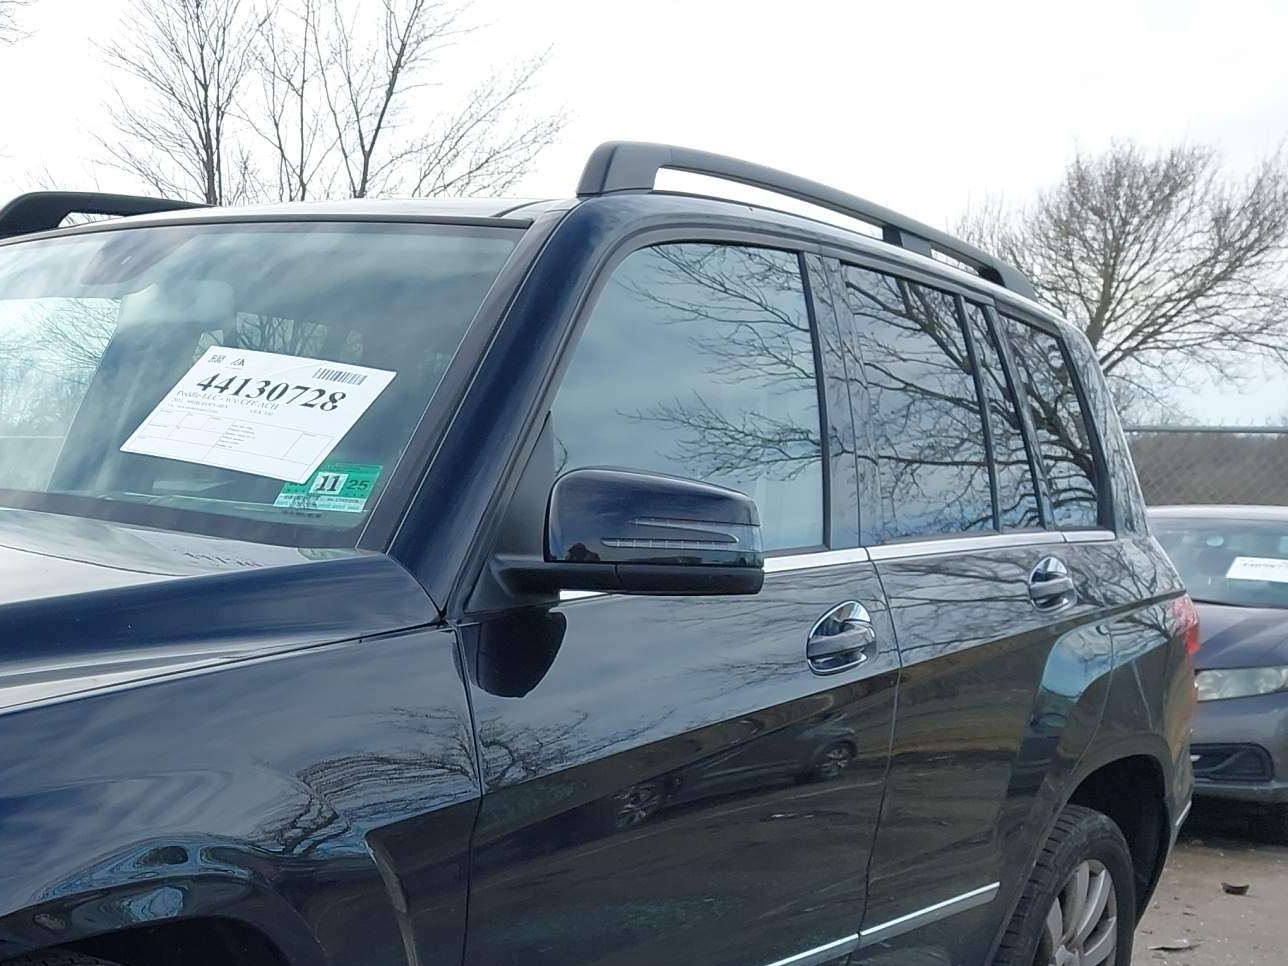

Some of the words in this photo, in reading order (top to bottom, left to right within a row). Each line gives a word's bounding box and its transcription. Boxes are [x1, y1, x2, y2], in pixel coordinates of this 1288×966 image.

[197, 373, 347, 412] 44130728
[315, 475, 341, 492] 11
[346, 479, 370, 491] 25
